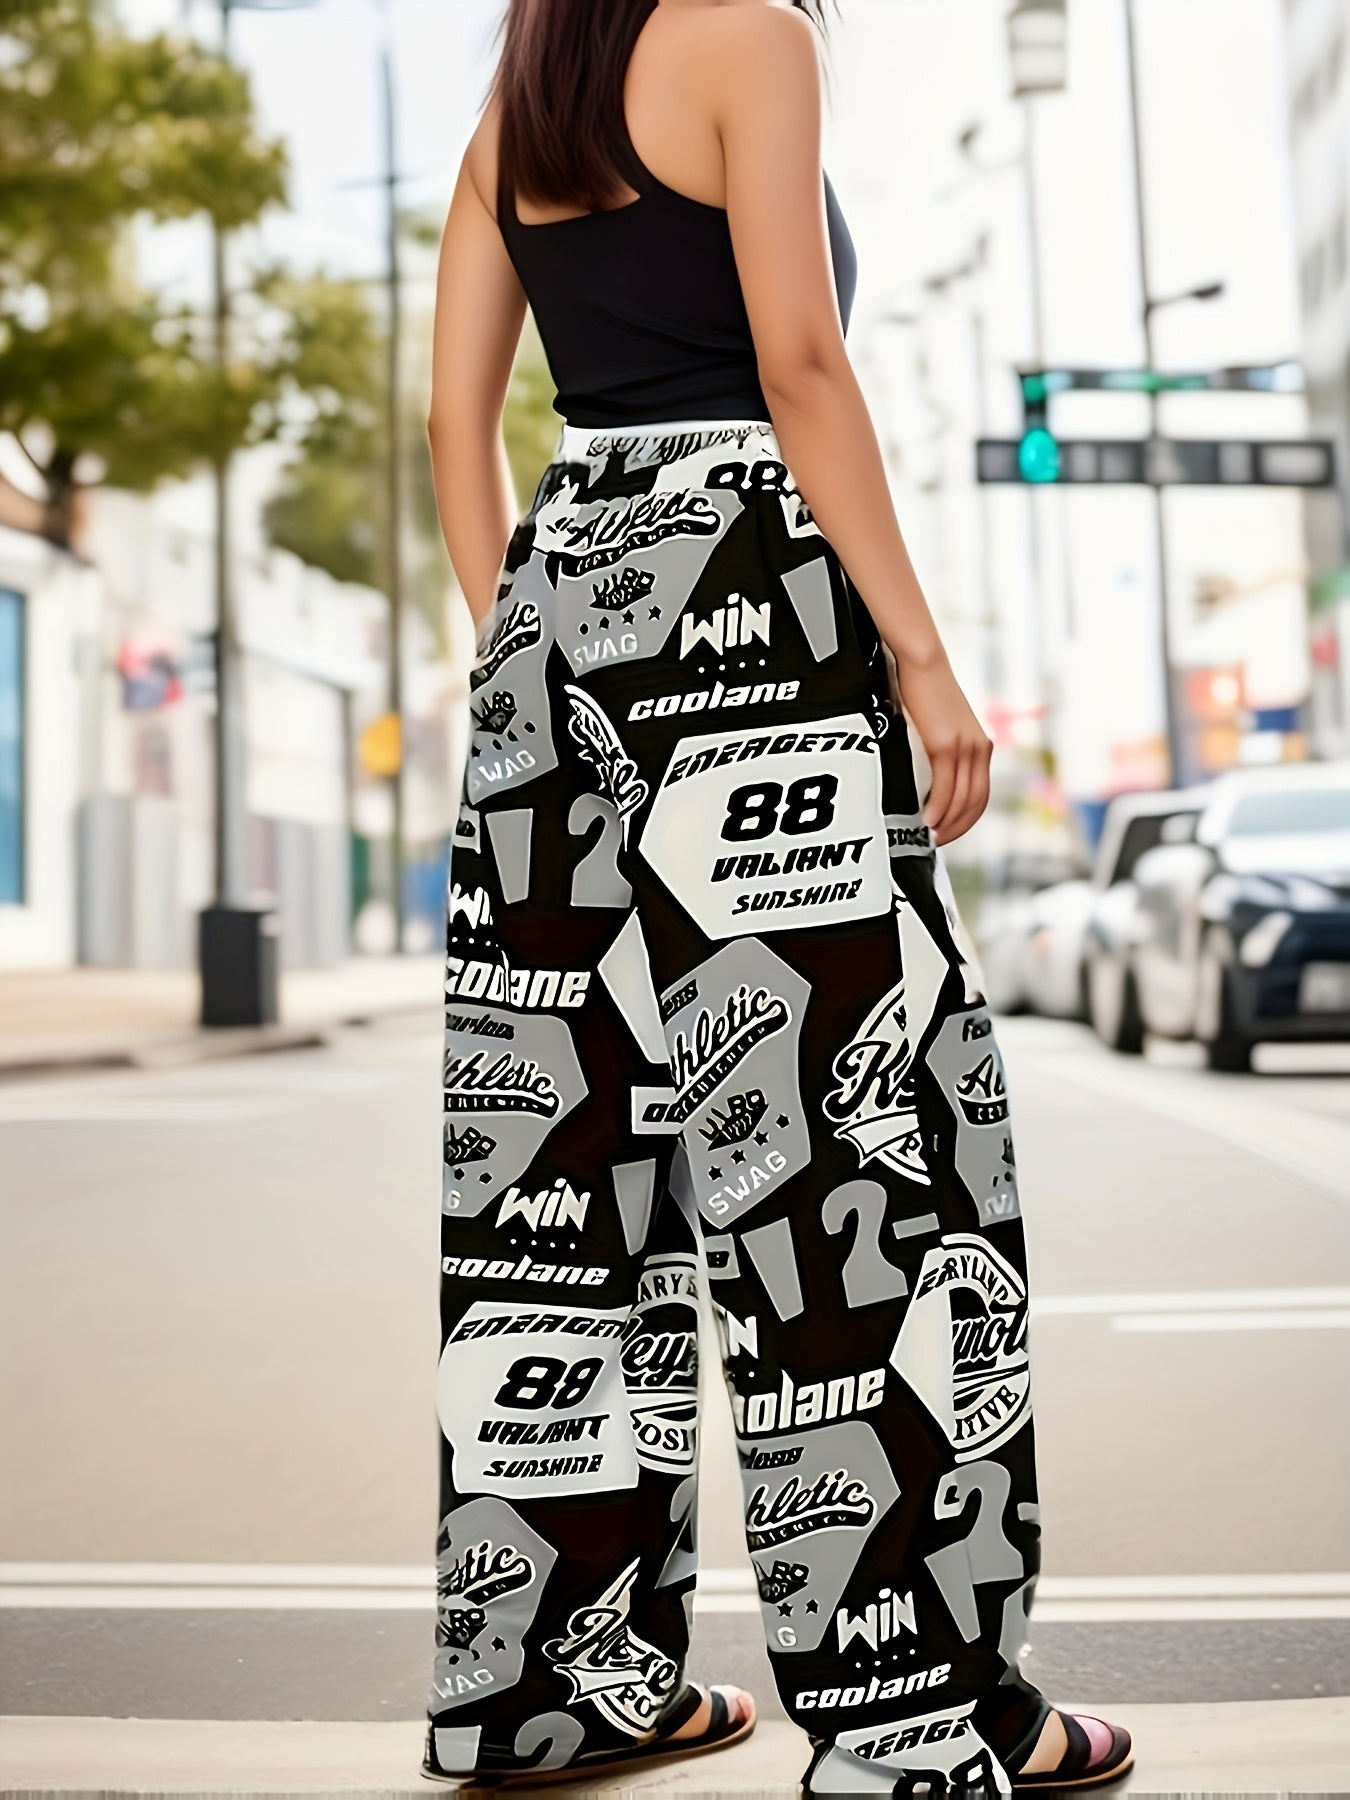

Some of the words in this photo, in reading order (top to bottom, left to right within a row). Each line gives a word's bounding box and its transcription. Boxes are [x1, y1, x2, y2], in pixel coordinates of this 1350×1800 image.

[627, 679, 800, 721] coolane
[720, 773, 840, 843] 88
[710, 836, 873, 883] VALIANT
[731, 879, 863, 915] SUNSHINE
[707, 1149, 787, 1216] SWAG
[442, 1254, 610, 1285] coolane
[494, 1355, 605, 1410] 88
[477, 1413, 610, 1445] VALIANT
[482, 1453, 604, 1479] SUNSHINE
[795, 1663, 952, 1710] coolane
